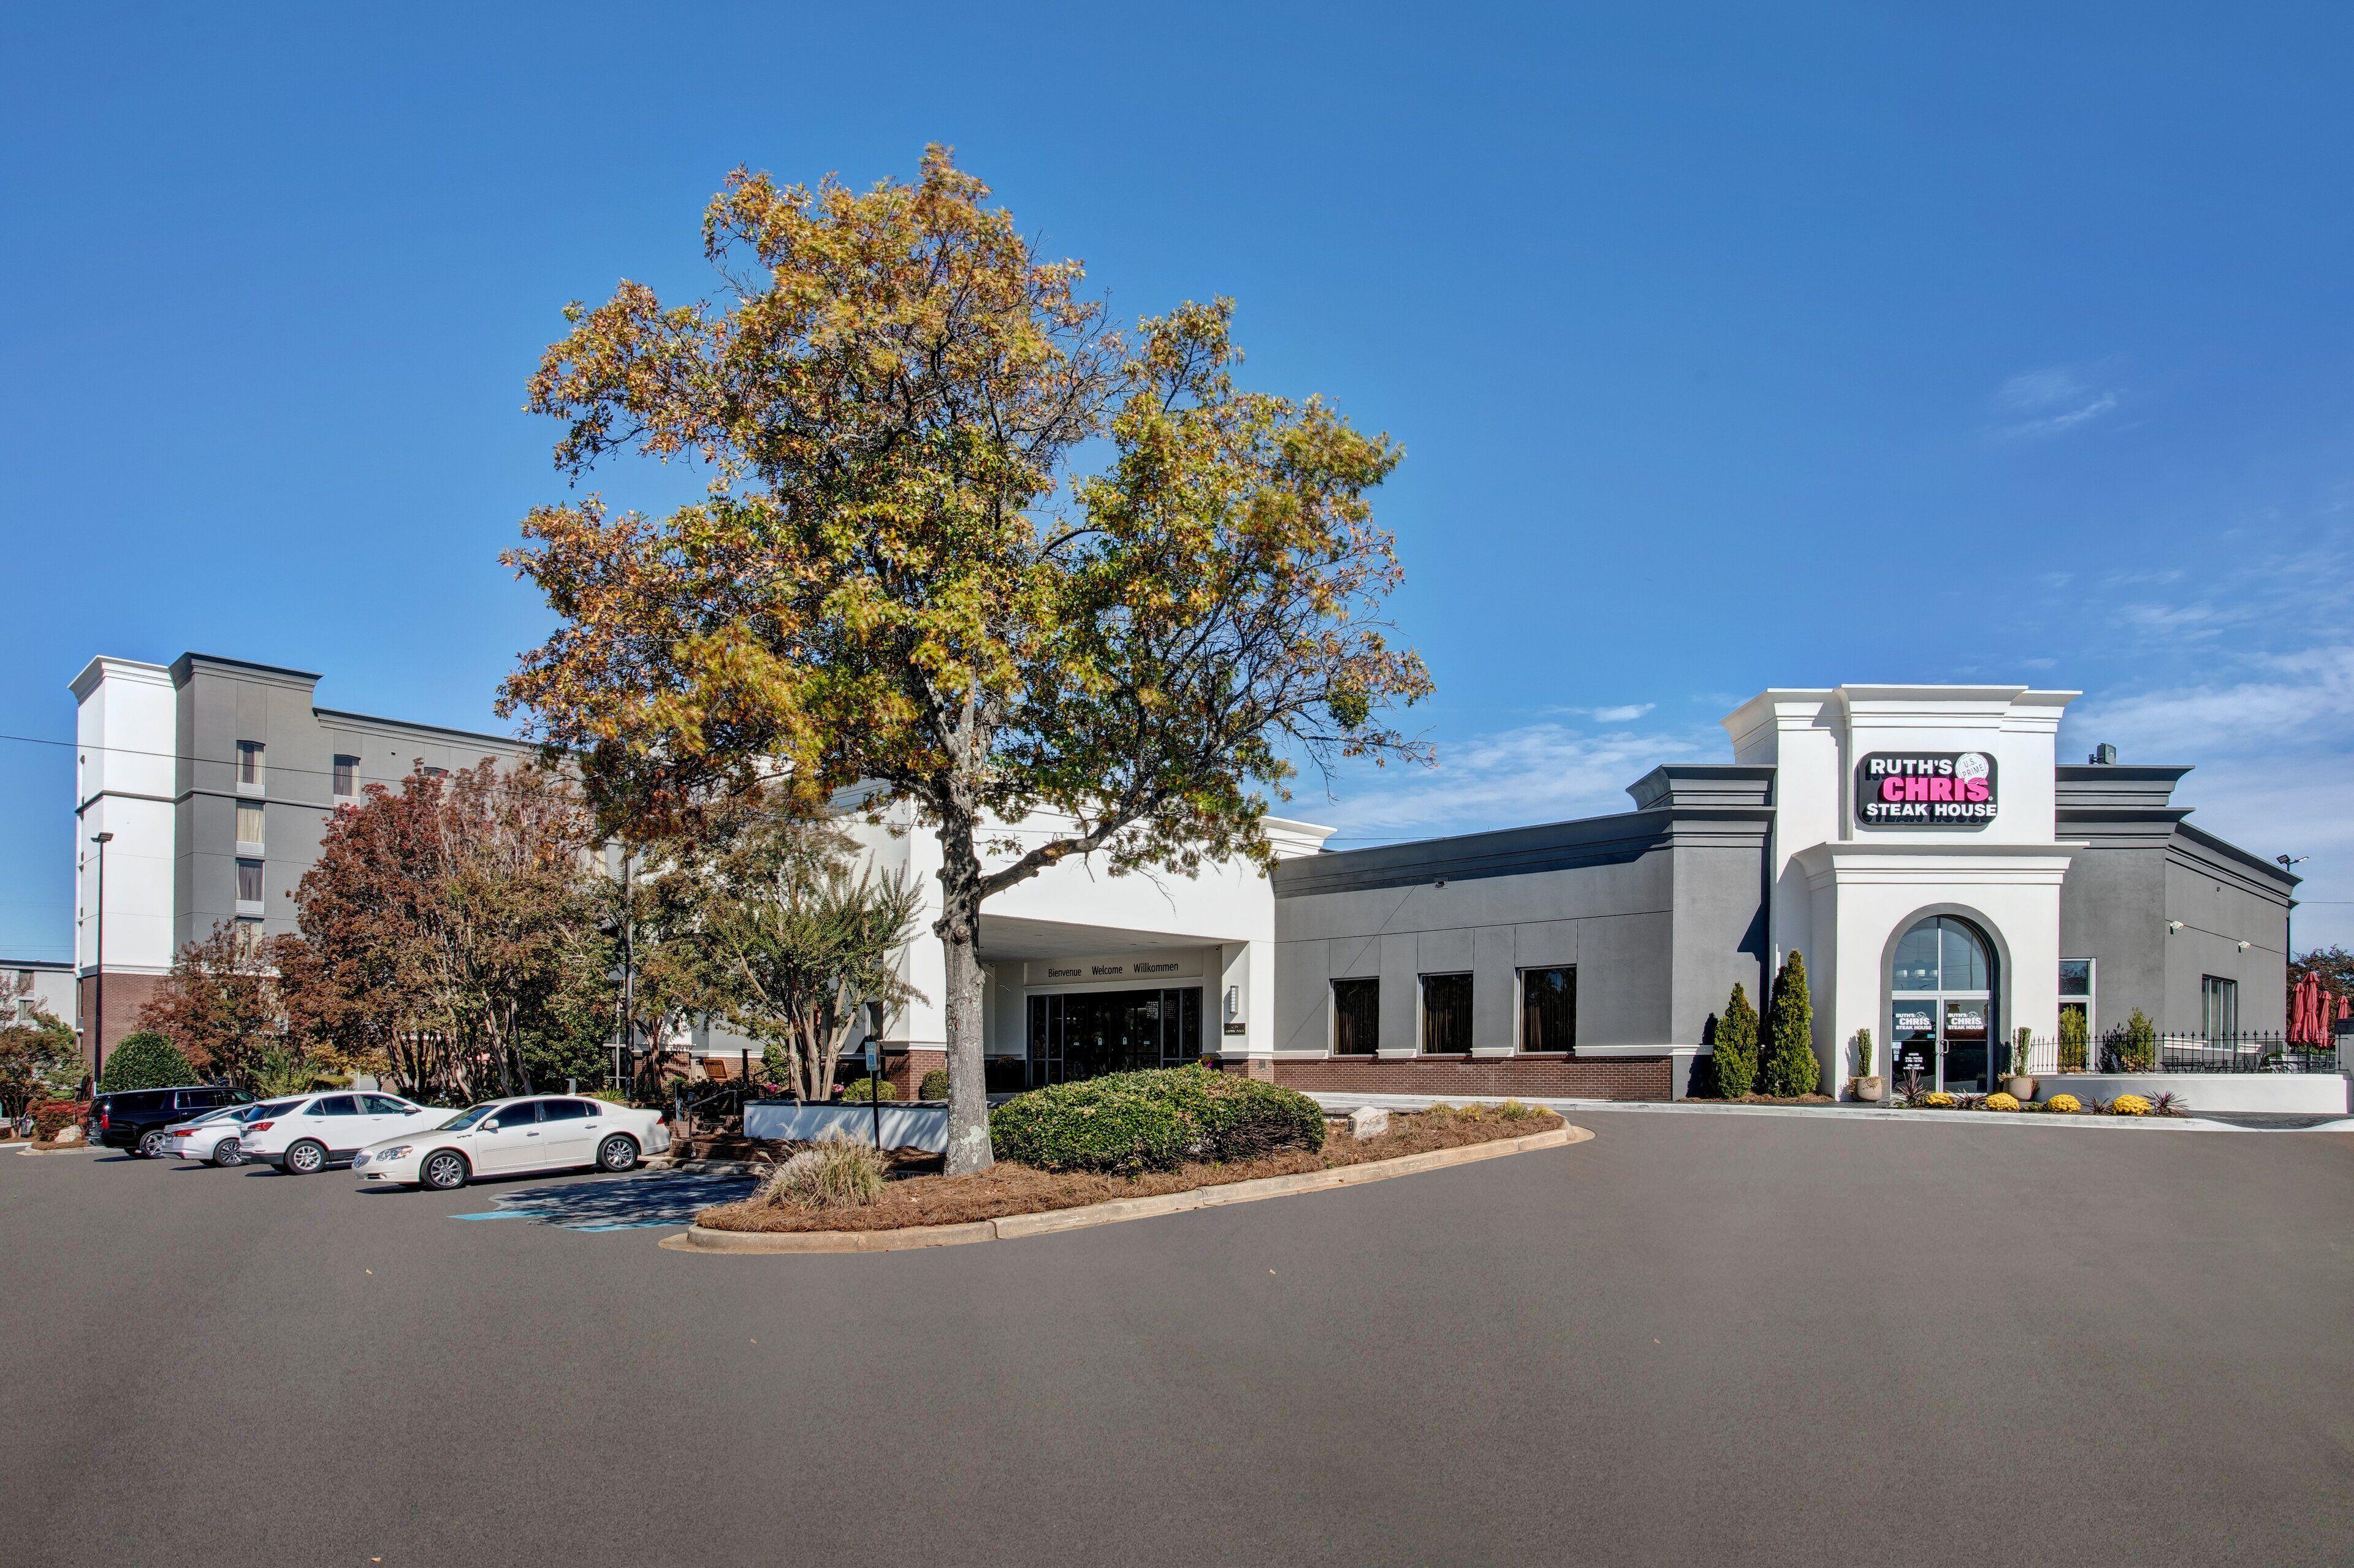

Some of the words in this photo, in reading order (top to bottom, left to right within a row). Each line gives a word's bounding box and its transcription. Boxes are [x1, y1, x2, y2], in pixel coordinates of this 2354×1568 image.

[1870, 759, 1952, 775] RUTH'S
[1963, 758, 1977, 768] U.S.
[1962, 764, 1984, 778] PRIME
[1883, 777, 1990, 802] CHRIS
[1867, 803, 1929, 816] STEAK
[1935, 803, 1997, 816] HOUSE
[1048, 969, 1081, 977] Bienvenue
[1092, 965, 1122, 975] Welcome
[1133, 962, 1179, 973] Willkommen
